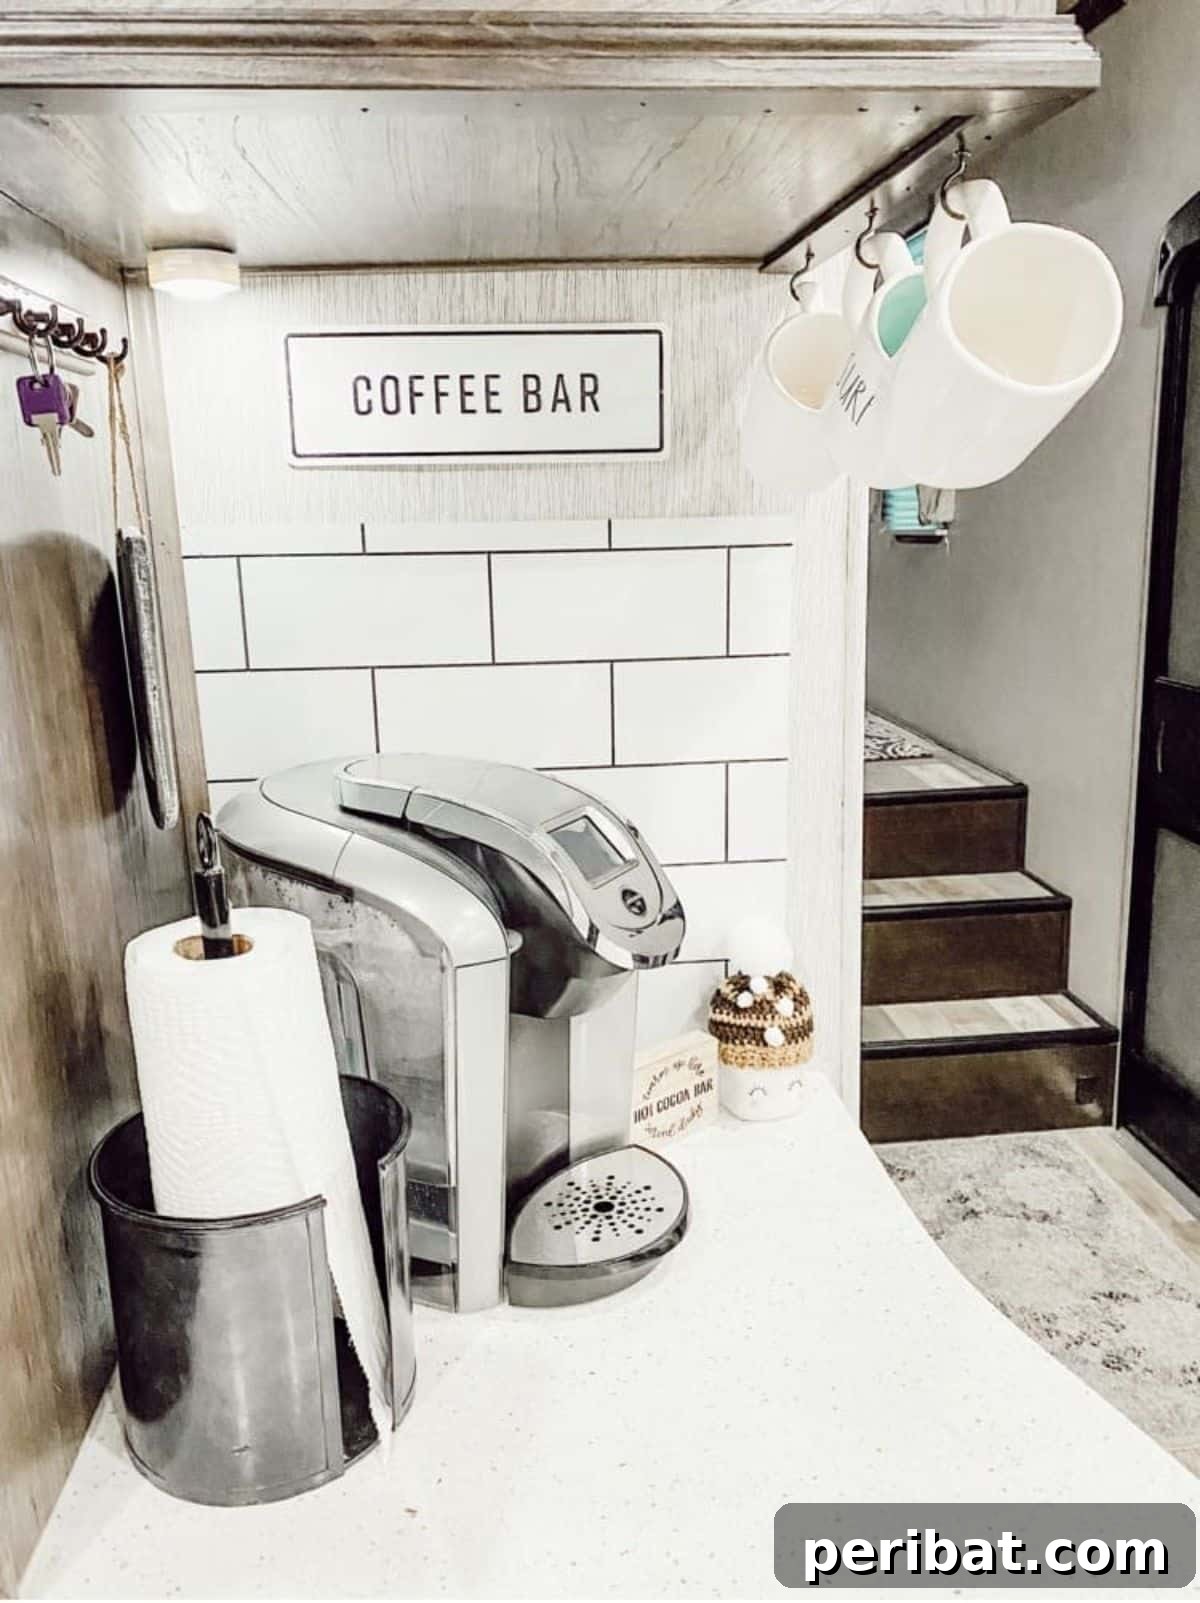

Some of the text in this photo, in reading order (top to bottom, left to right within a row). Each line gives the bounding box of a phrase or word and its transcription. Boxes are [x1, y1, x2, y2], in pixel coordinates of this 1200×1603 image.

[352, 372, 601, 416] COFFEE BAR
[633, 1103, 654, 1124] HOT
[656, 1087, 690, 1113] COCOA
[694, 1078, 713, 1097] BAR
